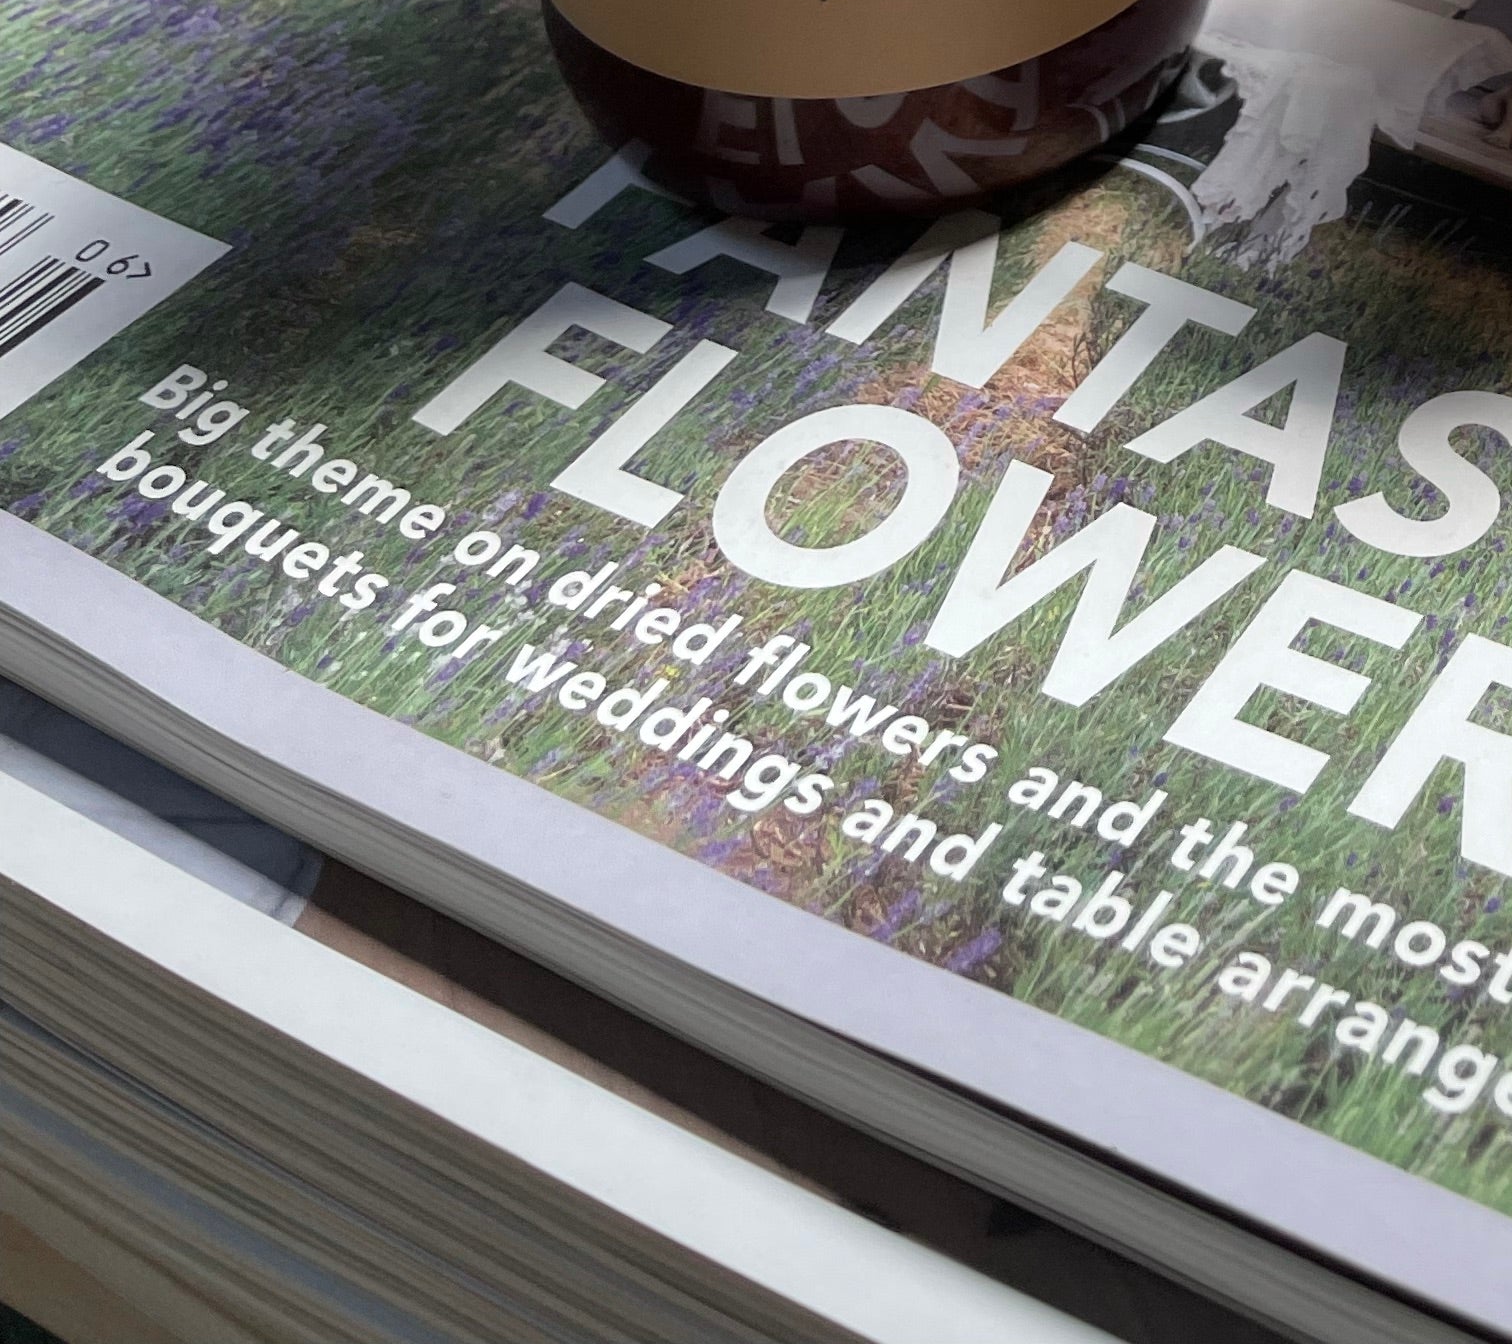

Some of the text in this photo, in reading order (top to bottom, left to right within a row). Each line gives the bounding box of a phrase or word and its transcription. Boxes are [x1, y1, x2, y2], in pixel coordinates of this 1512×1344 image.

[95, 429, 390, 616] bouquets
[390, 581, 502, 662] for
[504, 639, 836, 815] weddings
[841, 795, 1002, 881] and
[1000, 849, 1203, 970] table
[138, 363, 251, 447] Big
[250, 414, 447, 540] theme
[453, 529, 540, 584] on
[547, 560, 742, 666] dried
[734, 631, 999, 785] flowers
[1007, 766, 1168, 848] and
[1167, 815, 1300, 906] the
